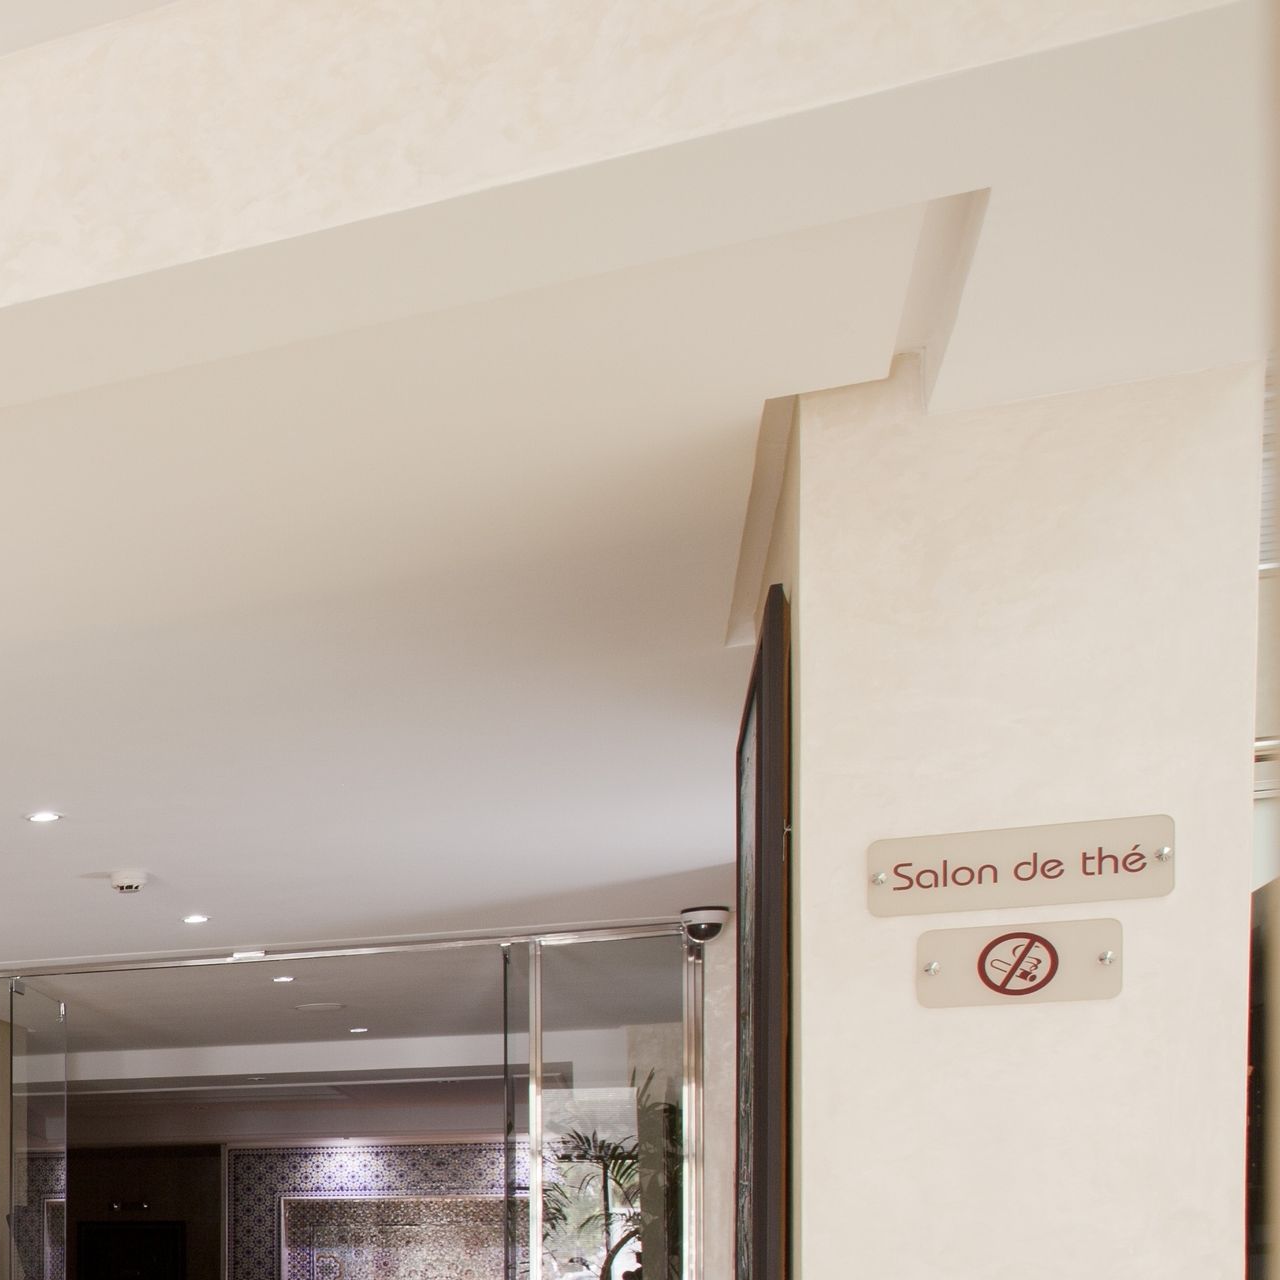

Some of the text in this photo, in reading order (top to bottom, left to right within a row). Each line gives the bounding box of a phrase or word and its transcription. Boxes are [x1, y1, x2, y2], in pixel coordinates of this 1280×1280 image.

[892, 844, 1148, 891] Salon de thé
